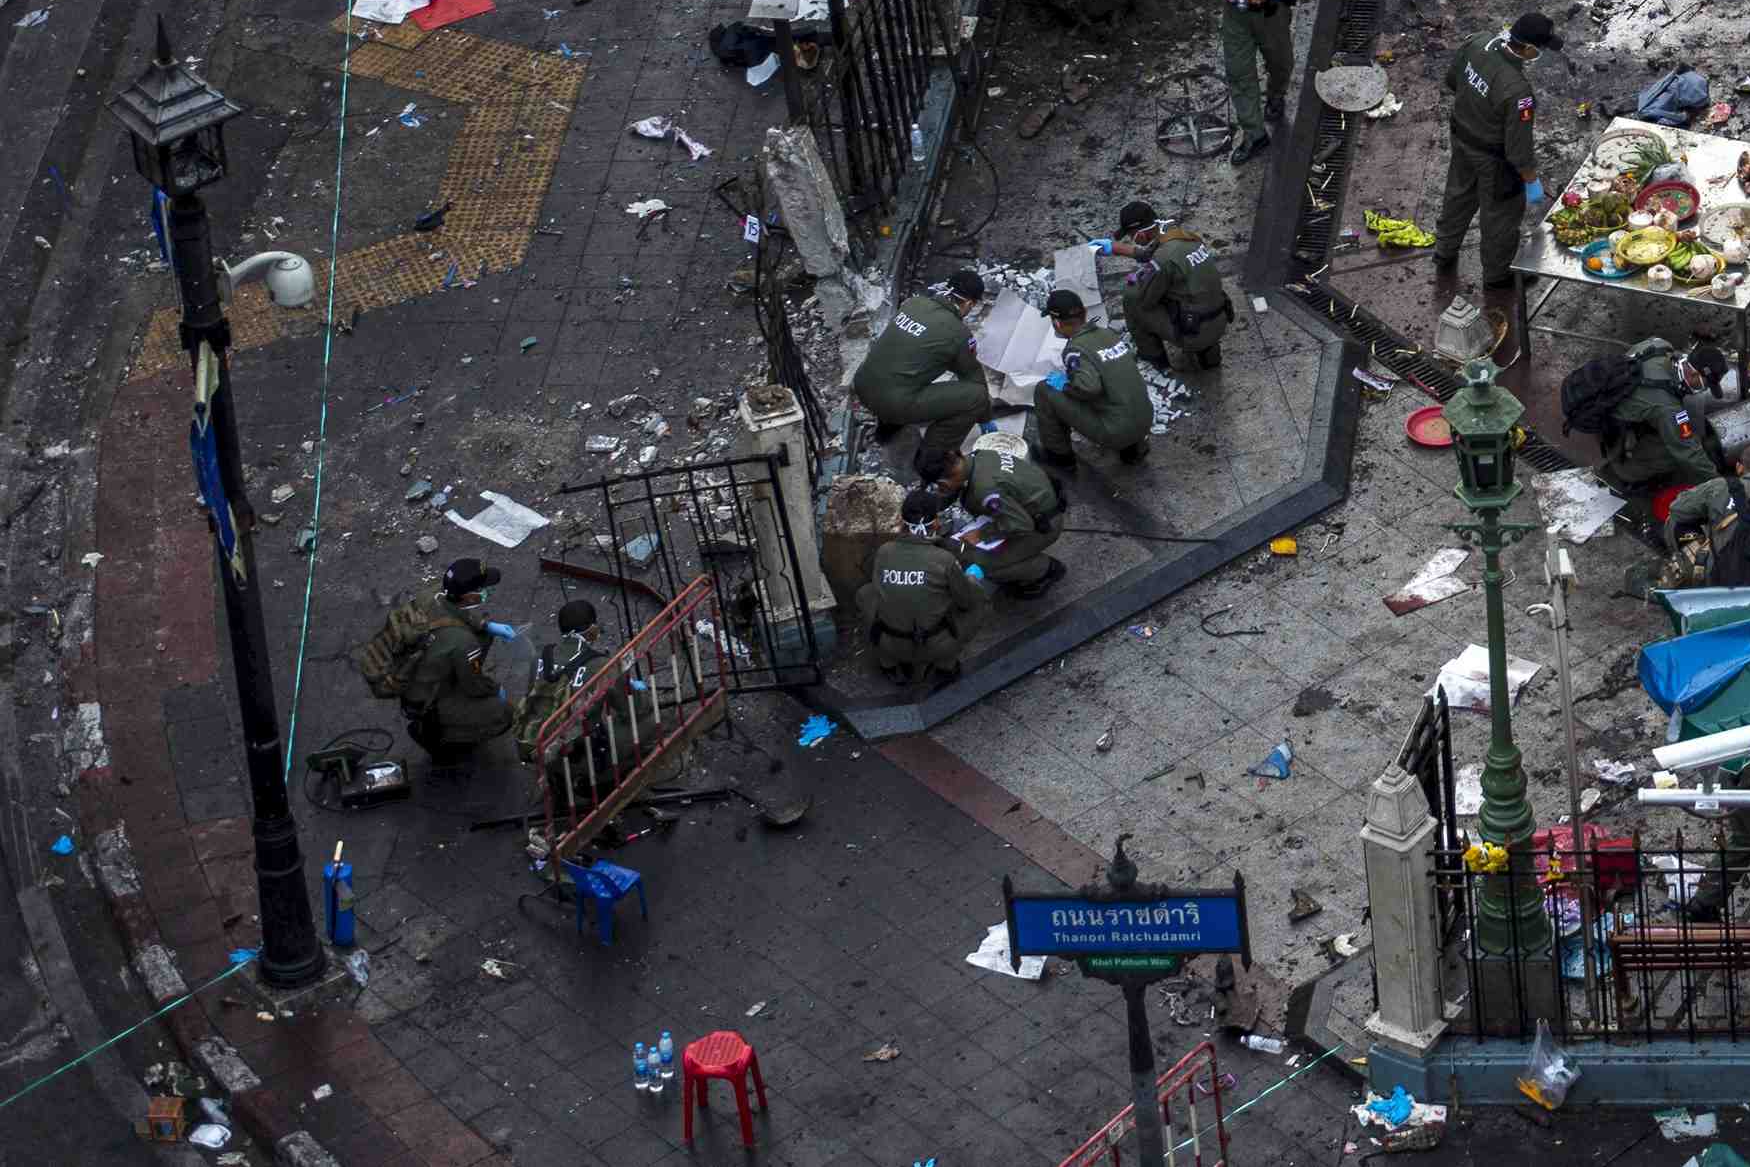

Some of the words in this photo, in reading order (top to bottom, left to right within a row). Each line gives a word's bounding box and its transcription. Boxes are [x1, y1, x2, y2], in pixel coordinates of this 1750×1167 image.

[883, 569, 925, 585] POLICE
[1051, 901, 1200, 926] ถนนราชดำริ
[1053, 932, 1105, 943] Thanon
[1111, 932, 1201, 942] Ratchadamri
